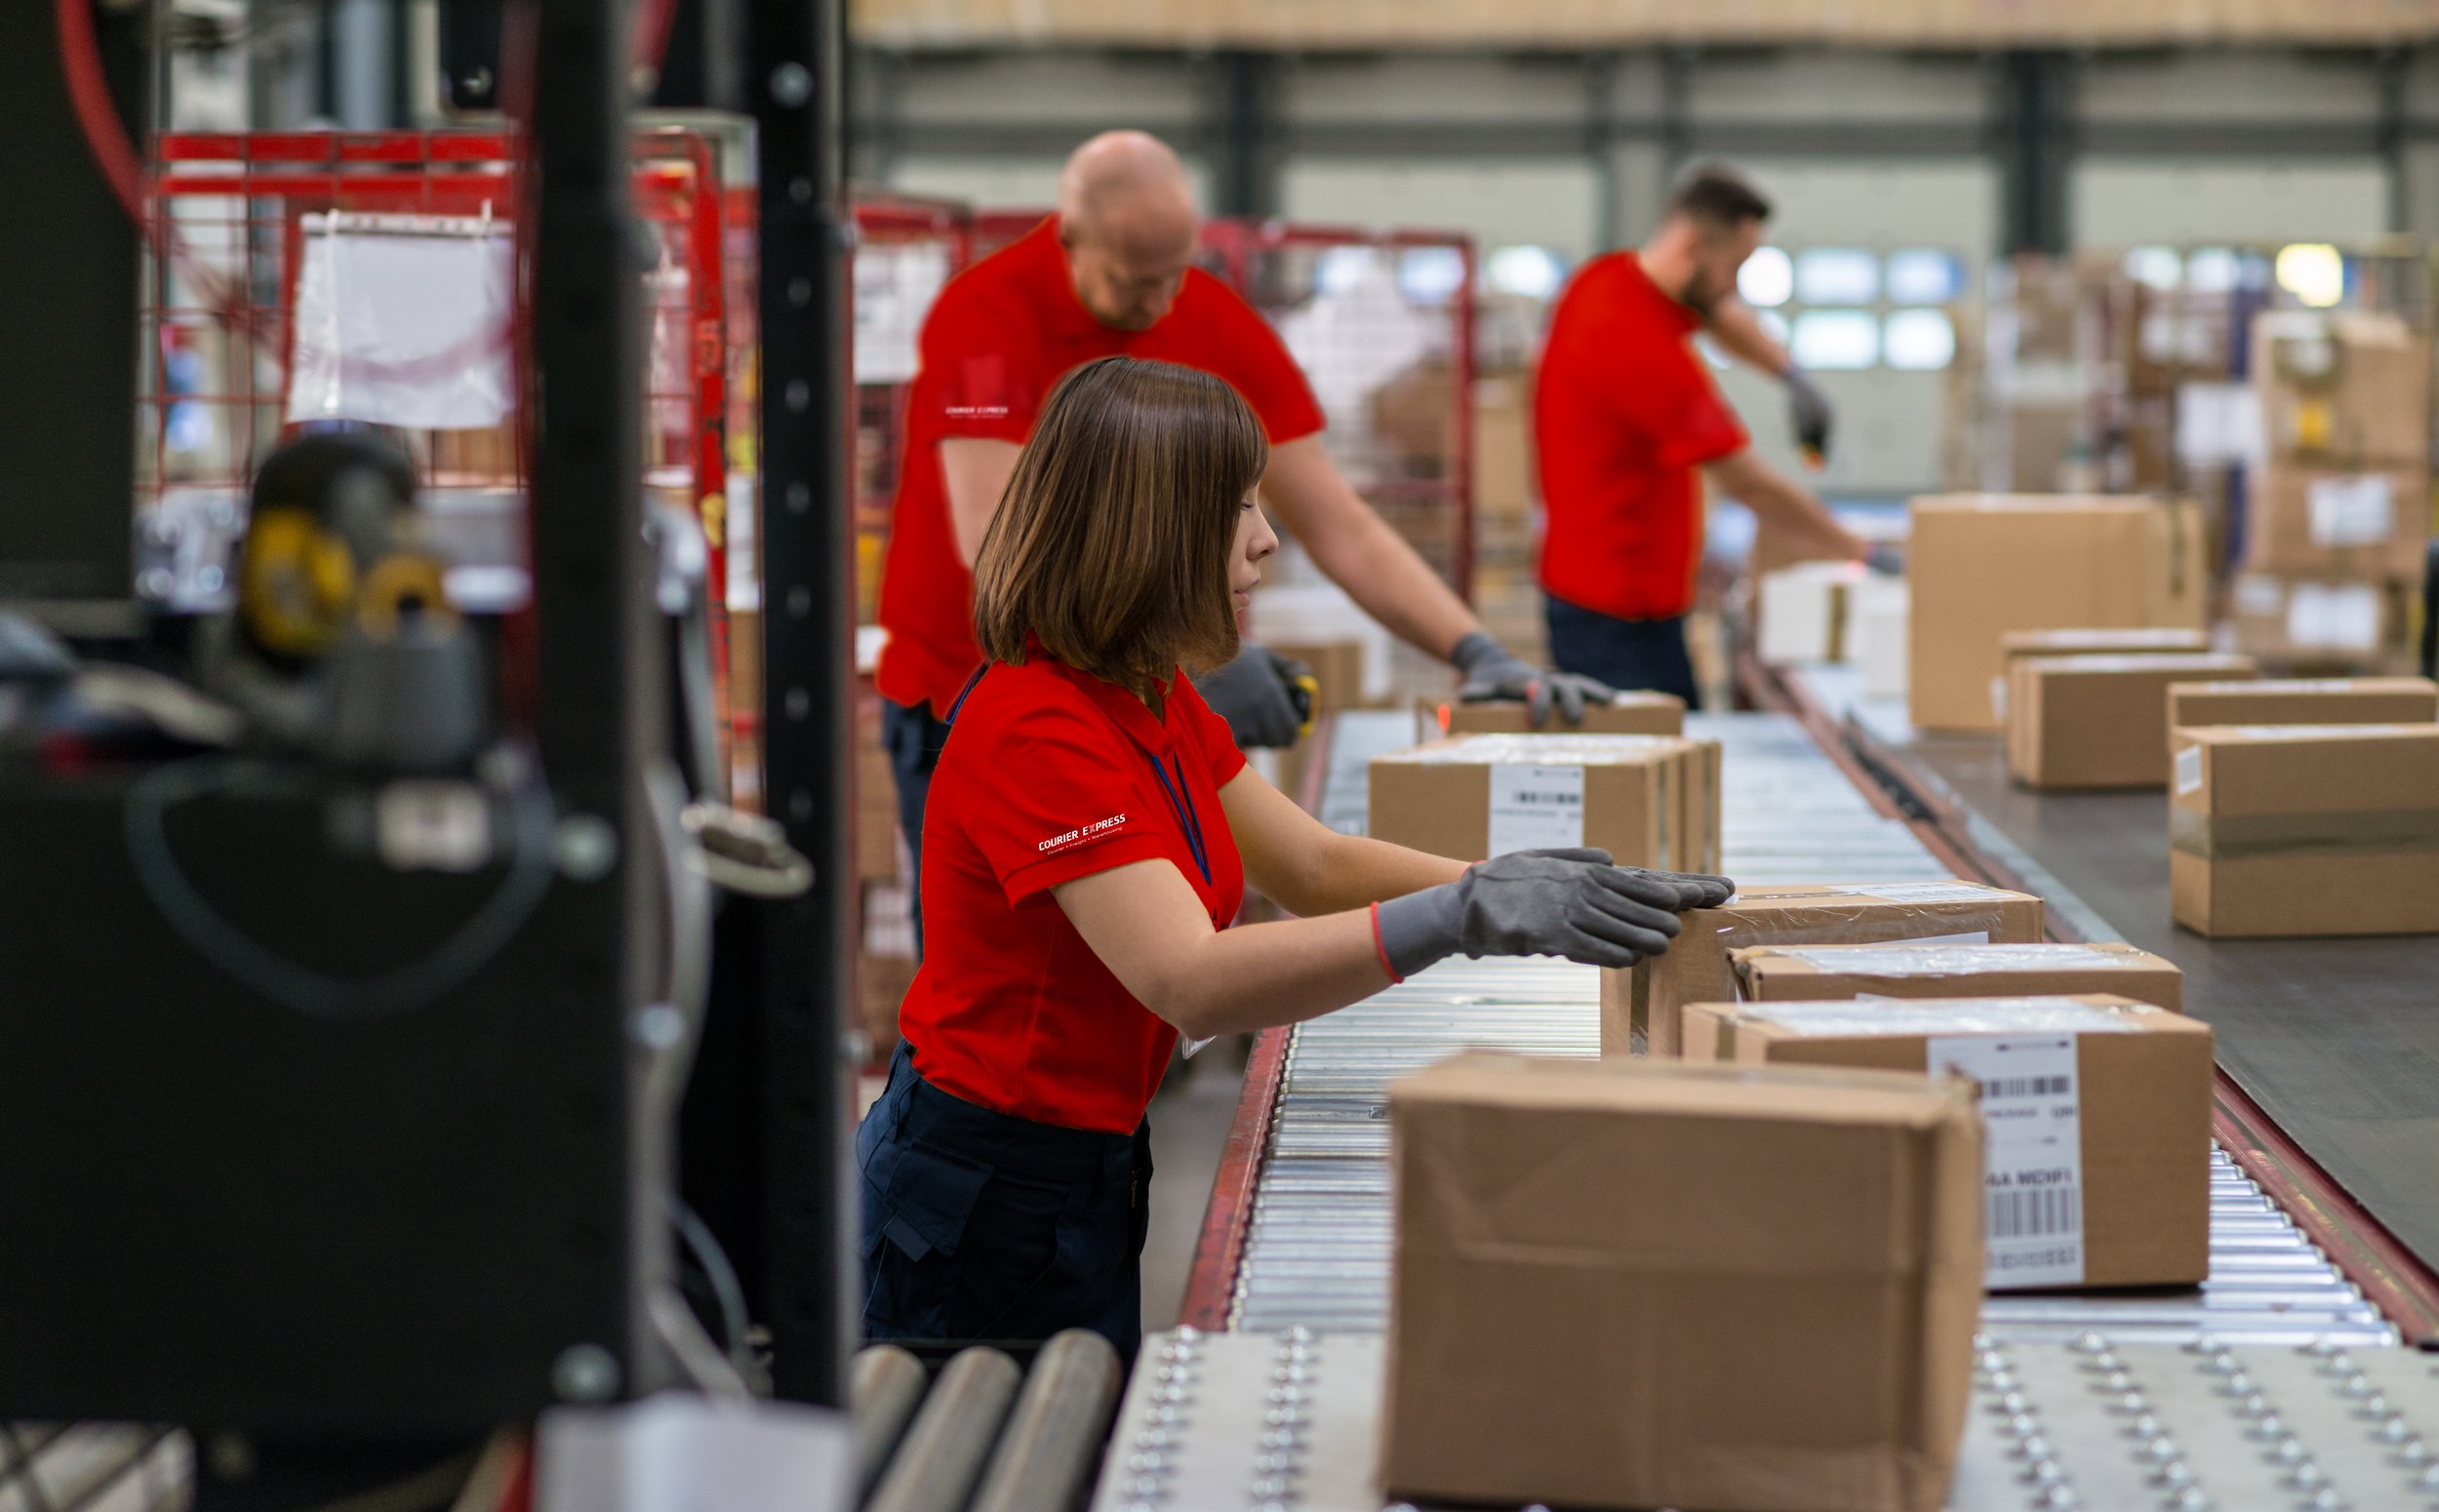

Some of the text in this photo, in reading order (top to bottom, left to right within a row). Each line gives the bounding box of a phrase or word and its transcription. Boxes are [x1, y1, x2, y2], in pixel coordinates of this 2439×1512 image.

[1038, 814, 1126, 852] COURIER EXPRESS
[1047, 826, 1123, 855] Courier Freight Warehousing
